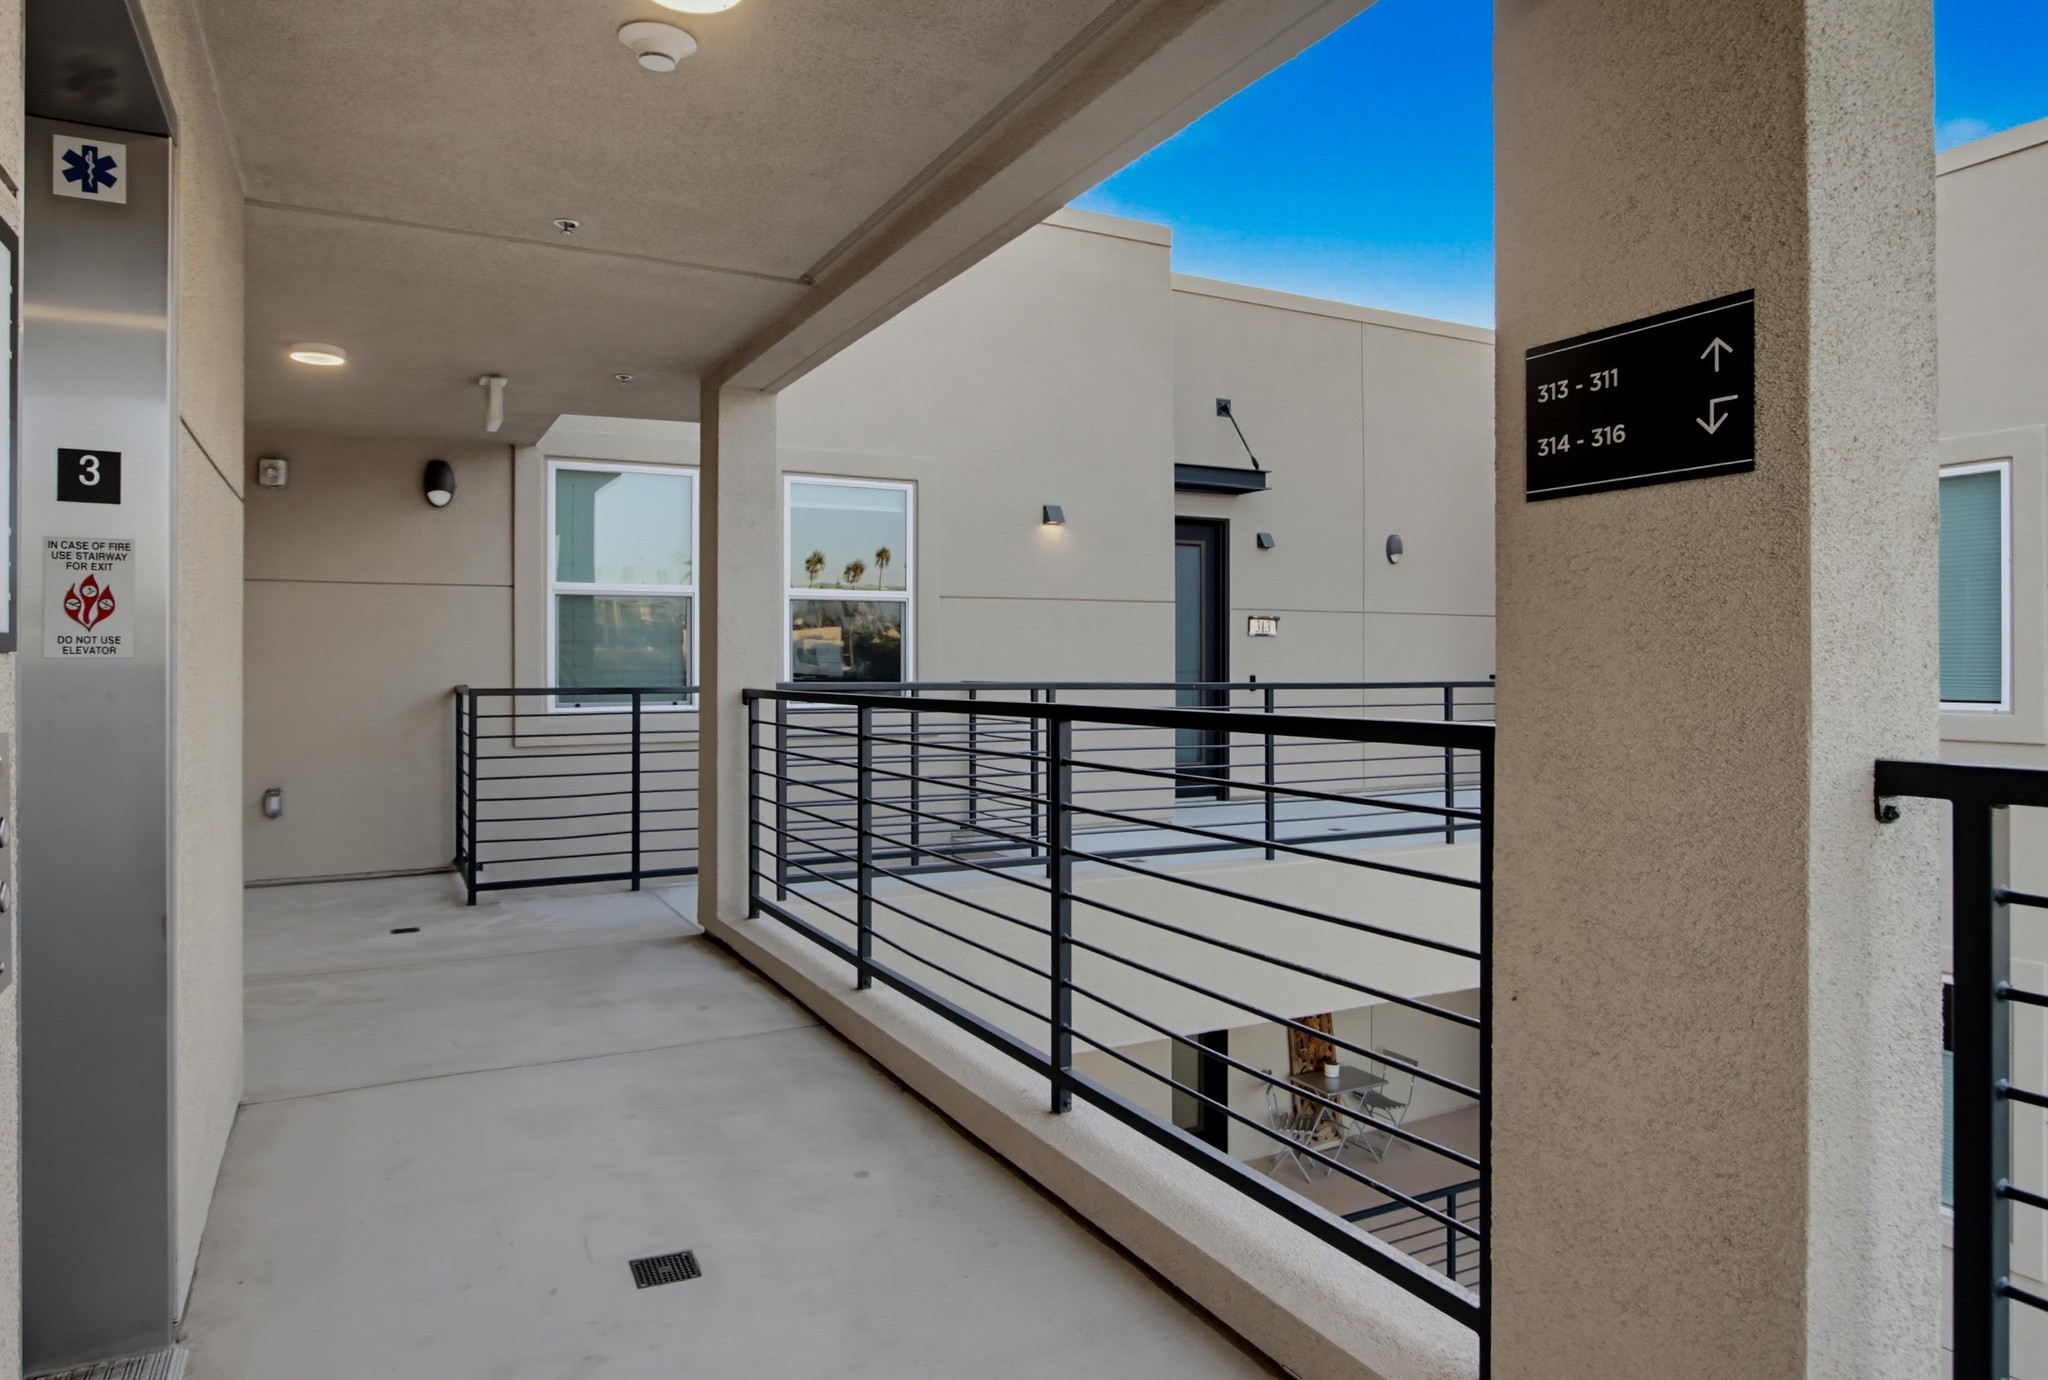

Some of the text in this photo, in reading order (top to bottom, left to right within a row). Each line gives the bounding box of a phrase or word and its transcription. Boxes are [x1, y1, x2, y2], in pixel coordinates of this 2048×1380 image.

[1537, 380, 1569, 403] 313
[1590, 368, 1619, 392] 311
[1537, 434, 1571, 456] 314
[1591, 424, 1626, 447] 316
[79, 454, 100, 486] 3
[47, 540, 132, 552] IN CASE OF FIRE
[51, 551, 128, 562] USE STAIRWAY
[66, 562, 114, 571] FOR EXIT
[57, 635, 122, 645] DO NOT USE
[62, 646, 117, 655] ELEVATOR
